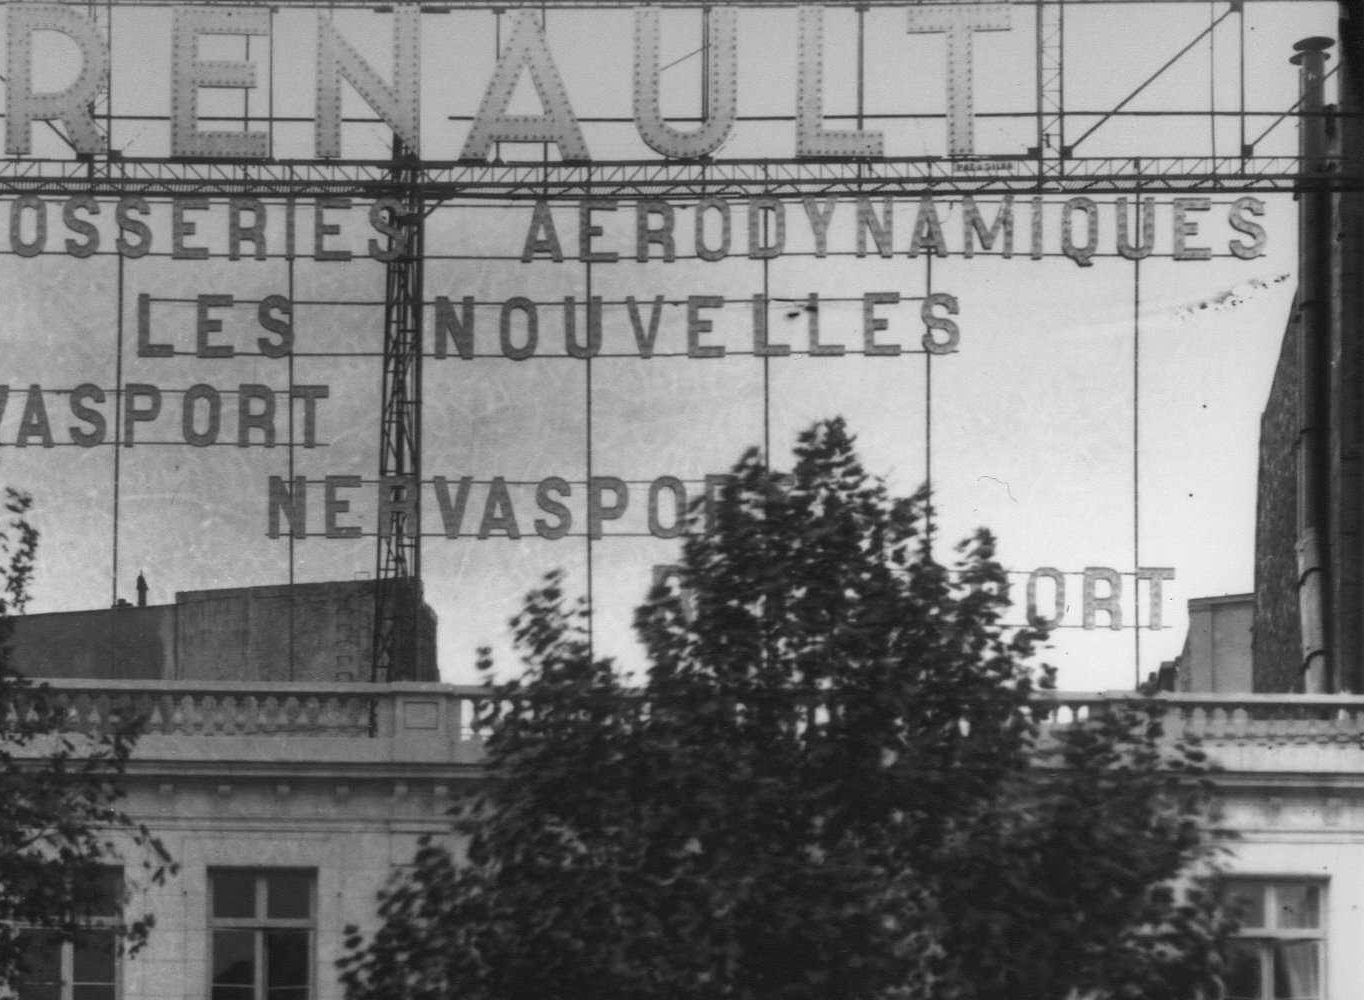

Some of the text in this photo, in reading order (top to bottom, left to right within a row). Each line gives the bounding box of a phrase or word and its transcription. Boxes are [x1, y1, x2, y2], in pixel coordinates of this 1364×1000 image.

[5, 4, 1012, 157] RENAULT
[521, 196, 1268, 267] AERODYNAMIQUES
[138, 293, 961, 362] LES NOUVELLES
